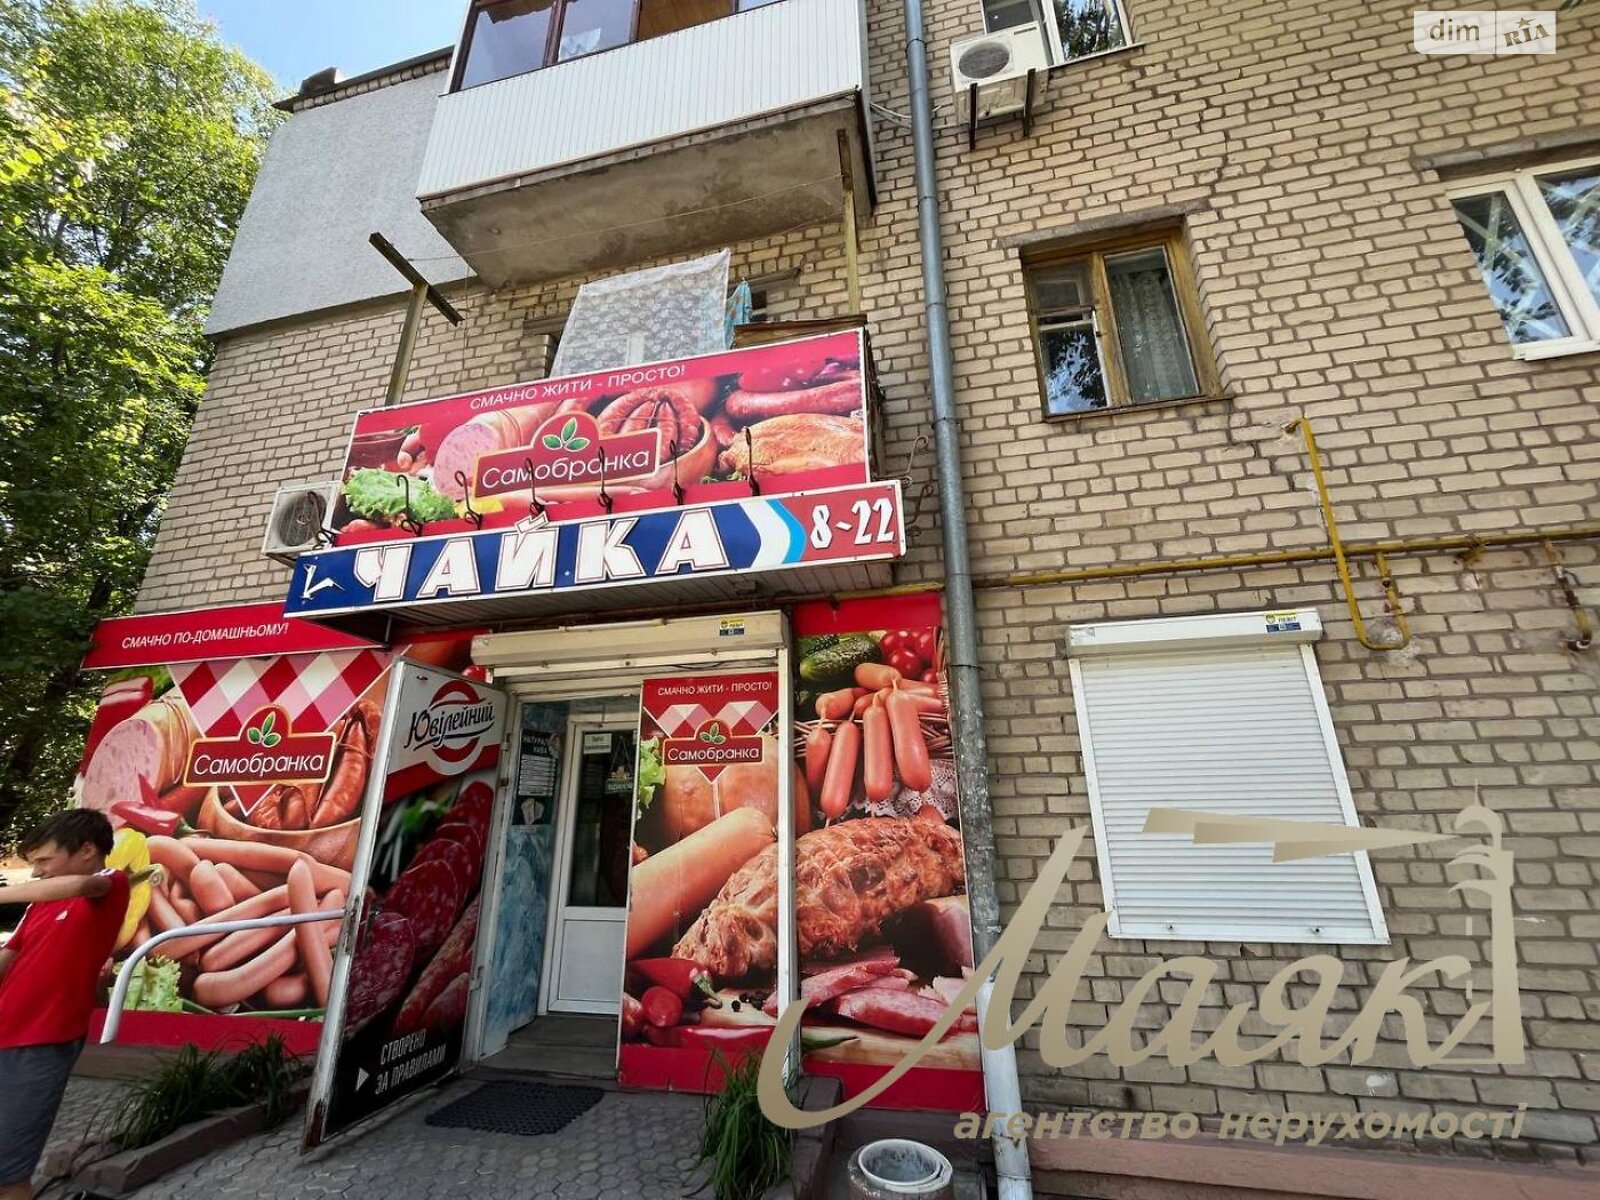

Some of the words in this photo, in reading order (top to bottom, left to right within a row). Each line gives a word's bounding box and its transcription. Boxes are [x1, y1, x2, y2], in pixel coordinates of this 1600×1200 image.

[470, 388, 537, 411] СМАЧНО
[542, 379, 592, 398] ЖИТИ
[608, 365, 685, 388] ПРОСТО!
[482, 450, 650, 489] Самобранка
[353, 507, 731, 602] ЧАЙКА
[122, 633, 172, 649] СМАЧНО
[173, 622, 290, 645] ПО-ДОМАШНЬОМУ!
[657, 687, 695, 696] СМАЧНО
[696, 684, 724, 694] ЖИТИ
[731, 681, 772, 692] ПРОСТО!
[403, 702, 494, 748] Ювілейний
[193, 752, 325, 777] Самобранка
[667, 747, 759, 762] Самобранка
